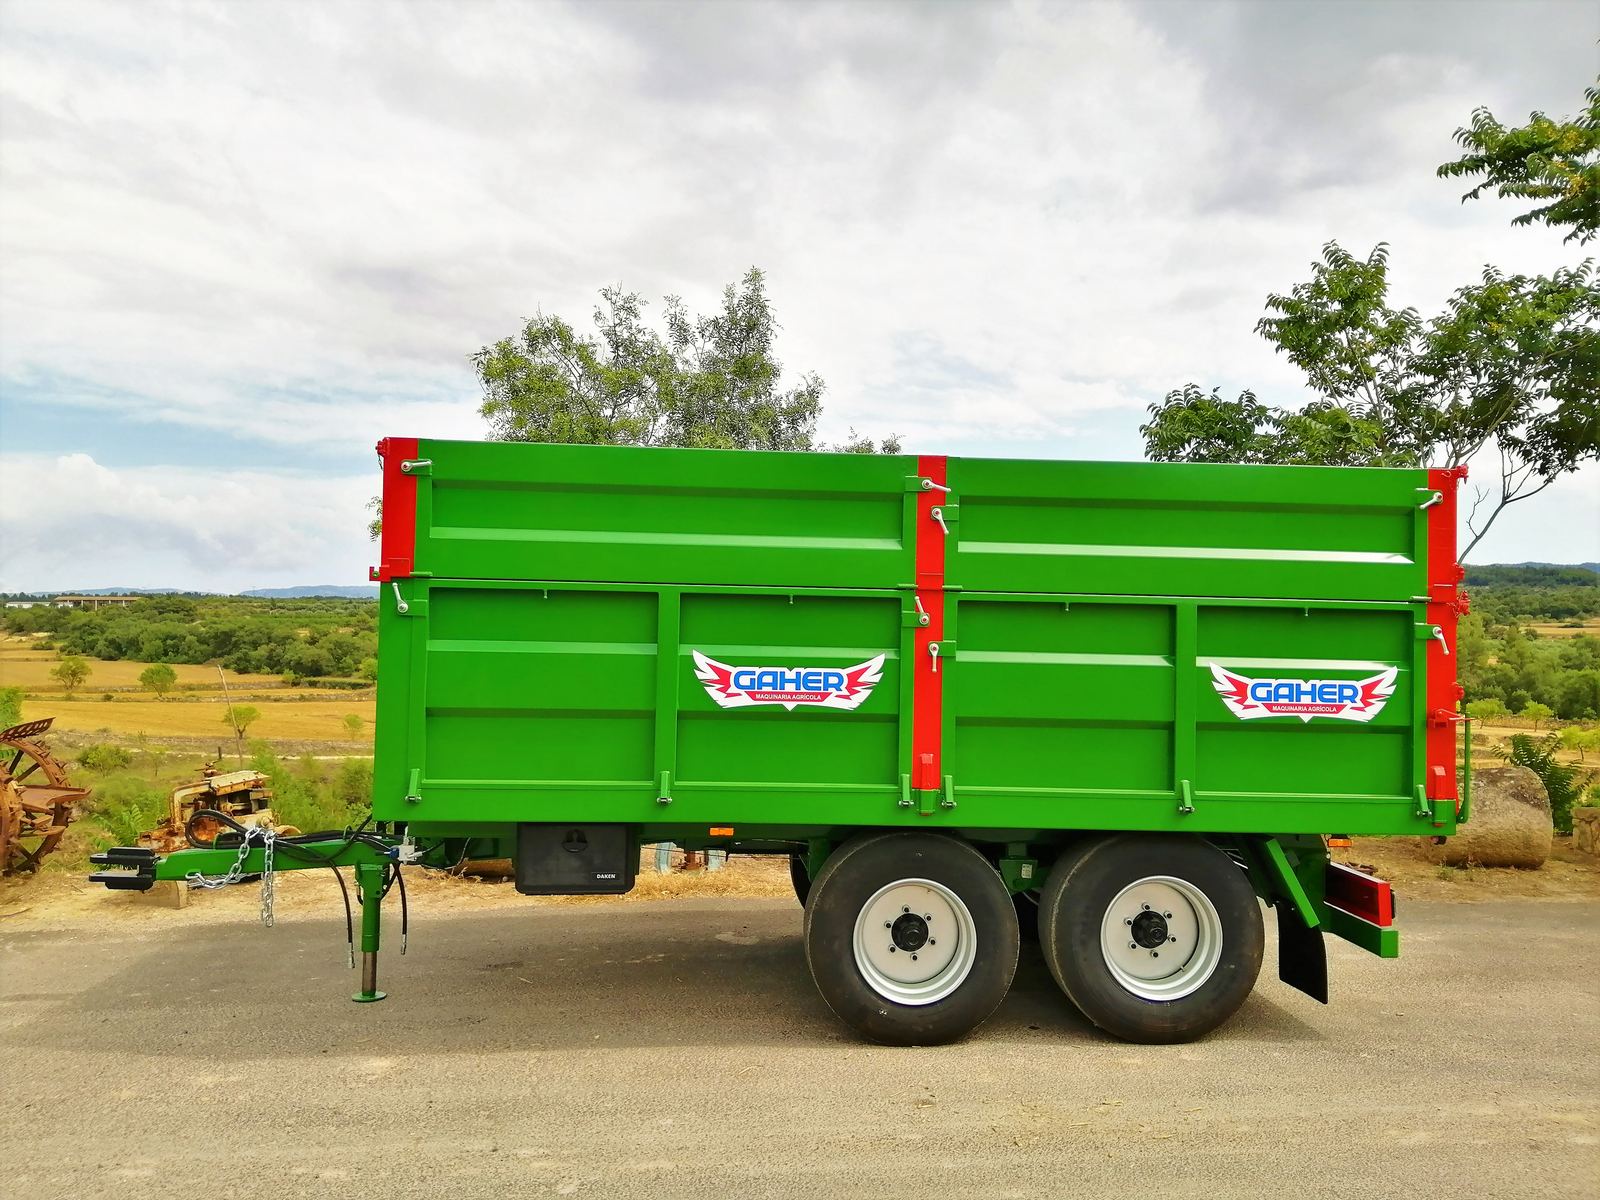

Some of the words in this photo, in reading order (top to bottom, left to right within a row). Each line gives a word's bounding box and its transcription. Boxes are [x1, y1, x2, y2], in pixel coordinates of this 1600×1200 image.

[733, 670, 845, 691] GAHER
[792, 693, 822, 701] AGRÍCOLA
[1250, 682, 1359, 703] GAHER
[1308, 705, 1337, 713] AGRÍCOLA
